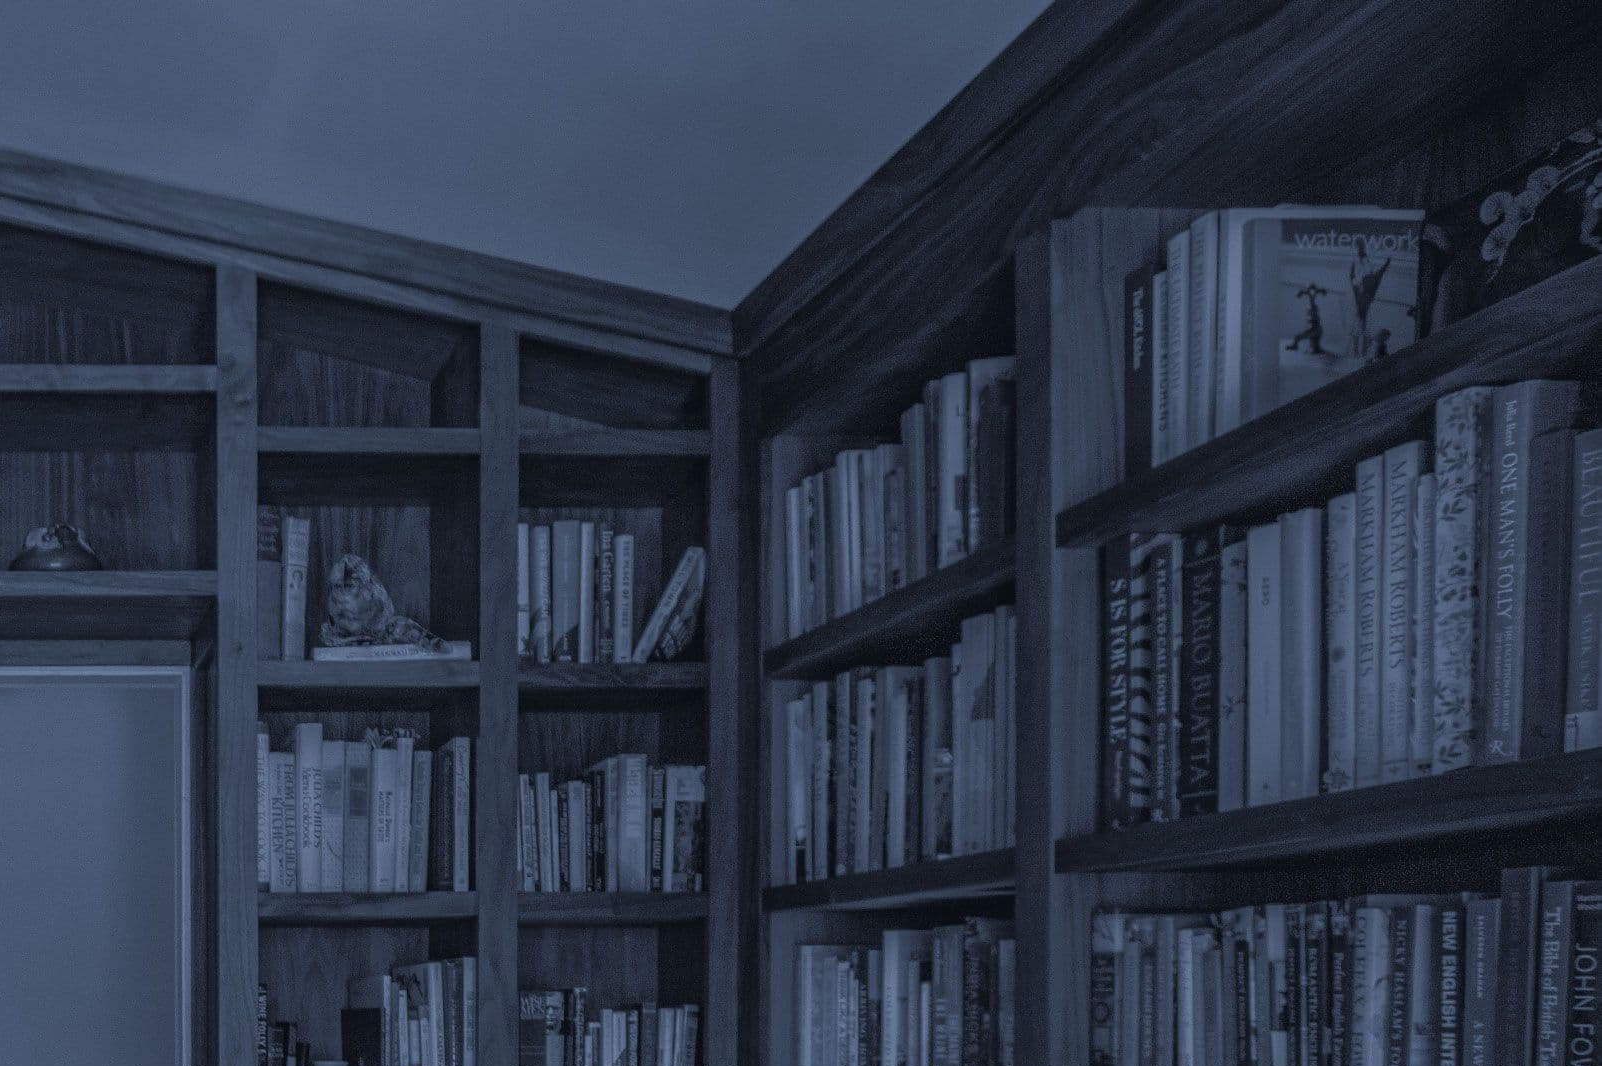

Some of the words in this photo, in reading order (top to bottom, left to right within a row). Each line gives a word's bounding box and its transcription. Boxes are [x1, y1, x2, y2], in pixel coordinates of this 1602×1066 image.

[1503, 400, 1518, 421] Julia
[1504, 424, 1517, 446] Reed
[1499, 452, 1519, 491] ONE
[1359, 473, 1376, 583] MARKHAM
[1389, 460, 1407, 573] MARKHAM
[1497, 499, 1518, 560] MAN'S
[1577, 451, 1602, 605] BEAUTIFUL
[601, 530, 614, 549] Ina
[623, 541, 631, 557] THE
[601, 551, 614, 592] Garten
[622, 559, 630, 587] PLACE
[1156, 558, 1166, 568] A
[621, 589, 629, 600] OF
[662, 581, 683, 609] TOWN
[1109, 578, 1127, 594] S
[1156, 571, 1166, 613] PLACE
[1496, 564, 1514, 619] FOLLY
[1109, 599, 1127, 621] IS
[1156, 616, 1166, 634] TO
[1190, 571, 1213, 665] MARIO
[1388, 581, 1407, 670] ROBERTS
[1109, 626, 1127, 669] FOR
[1359, 590, 1376, 678] ROBERTS
[1156, 637, 1166, 671] CALL
[1109, 674, 1127, 744] STYLE
[1156, 674, 1166, 715] HOME
[1188, 673, 1212, 784] BUATTA
[256, 757, 266, 780] THE
[284, 763, 295, 800] FROM
[302, 768, 312, 796] Menu
[312, 768, 322, 800] JULIA
[257, 783, 266, 808] WAY
[257, 810, 266, 826] TO
[271, 797, 283, 853] KITCHEN
[282, 803, 295, 837] JULIA
[302, 797, 313, 849] Cookbook
[313, 802, 322, 849] CHILD'S
[257, 828, 266, 864] COOK
[284, 838, 295, 888] CHILD'S
[1441, 911, 1458, 951] NEW
[1543, 906, 1563, 936] The
[1353, 915, 1368, 1008] COLEFAX
[1394, 919, 1408, 966] NICKY
[1542, 941, 1561, 975] Bible
[1308, 948, 1318, 1017] ROMANTIC
[1332, 953, 1346, 991] Perfect
[1542, 978, 1558, 992] of
[1572, 943, 1597, 1011] JOHN
[258, 994, 267, 1018] WINE
[1390, 971, 1405, 1040] HASLAM'S
[1440, 956, 1457, 1028] ENGLISH
[1331, 993, 1345, 1035] English
[1352, 1011, 1367, 1026] &
[1474, 1020, 1484, 1030] A
[1539, 994, 1558, 1039] British
[258, 1020, 267, 1048] FOLLY
[1472, 1034, 1484, 1066] NEW
